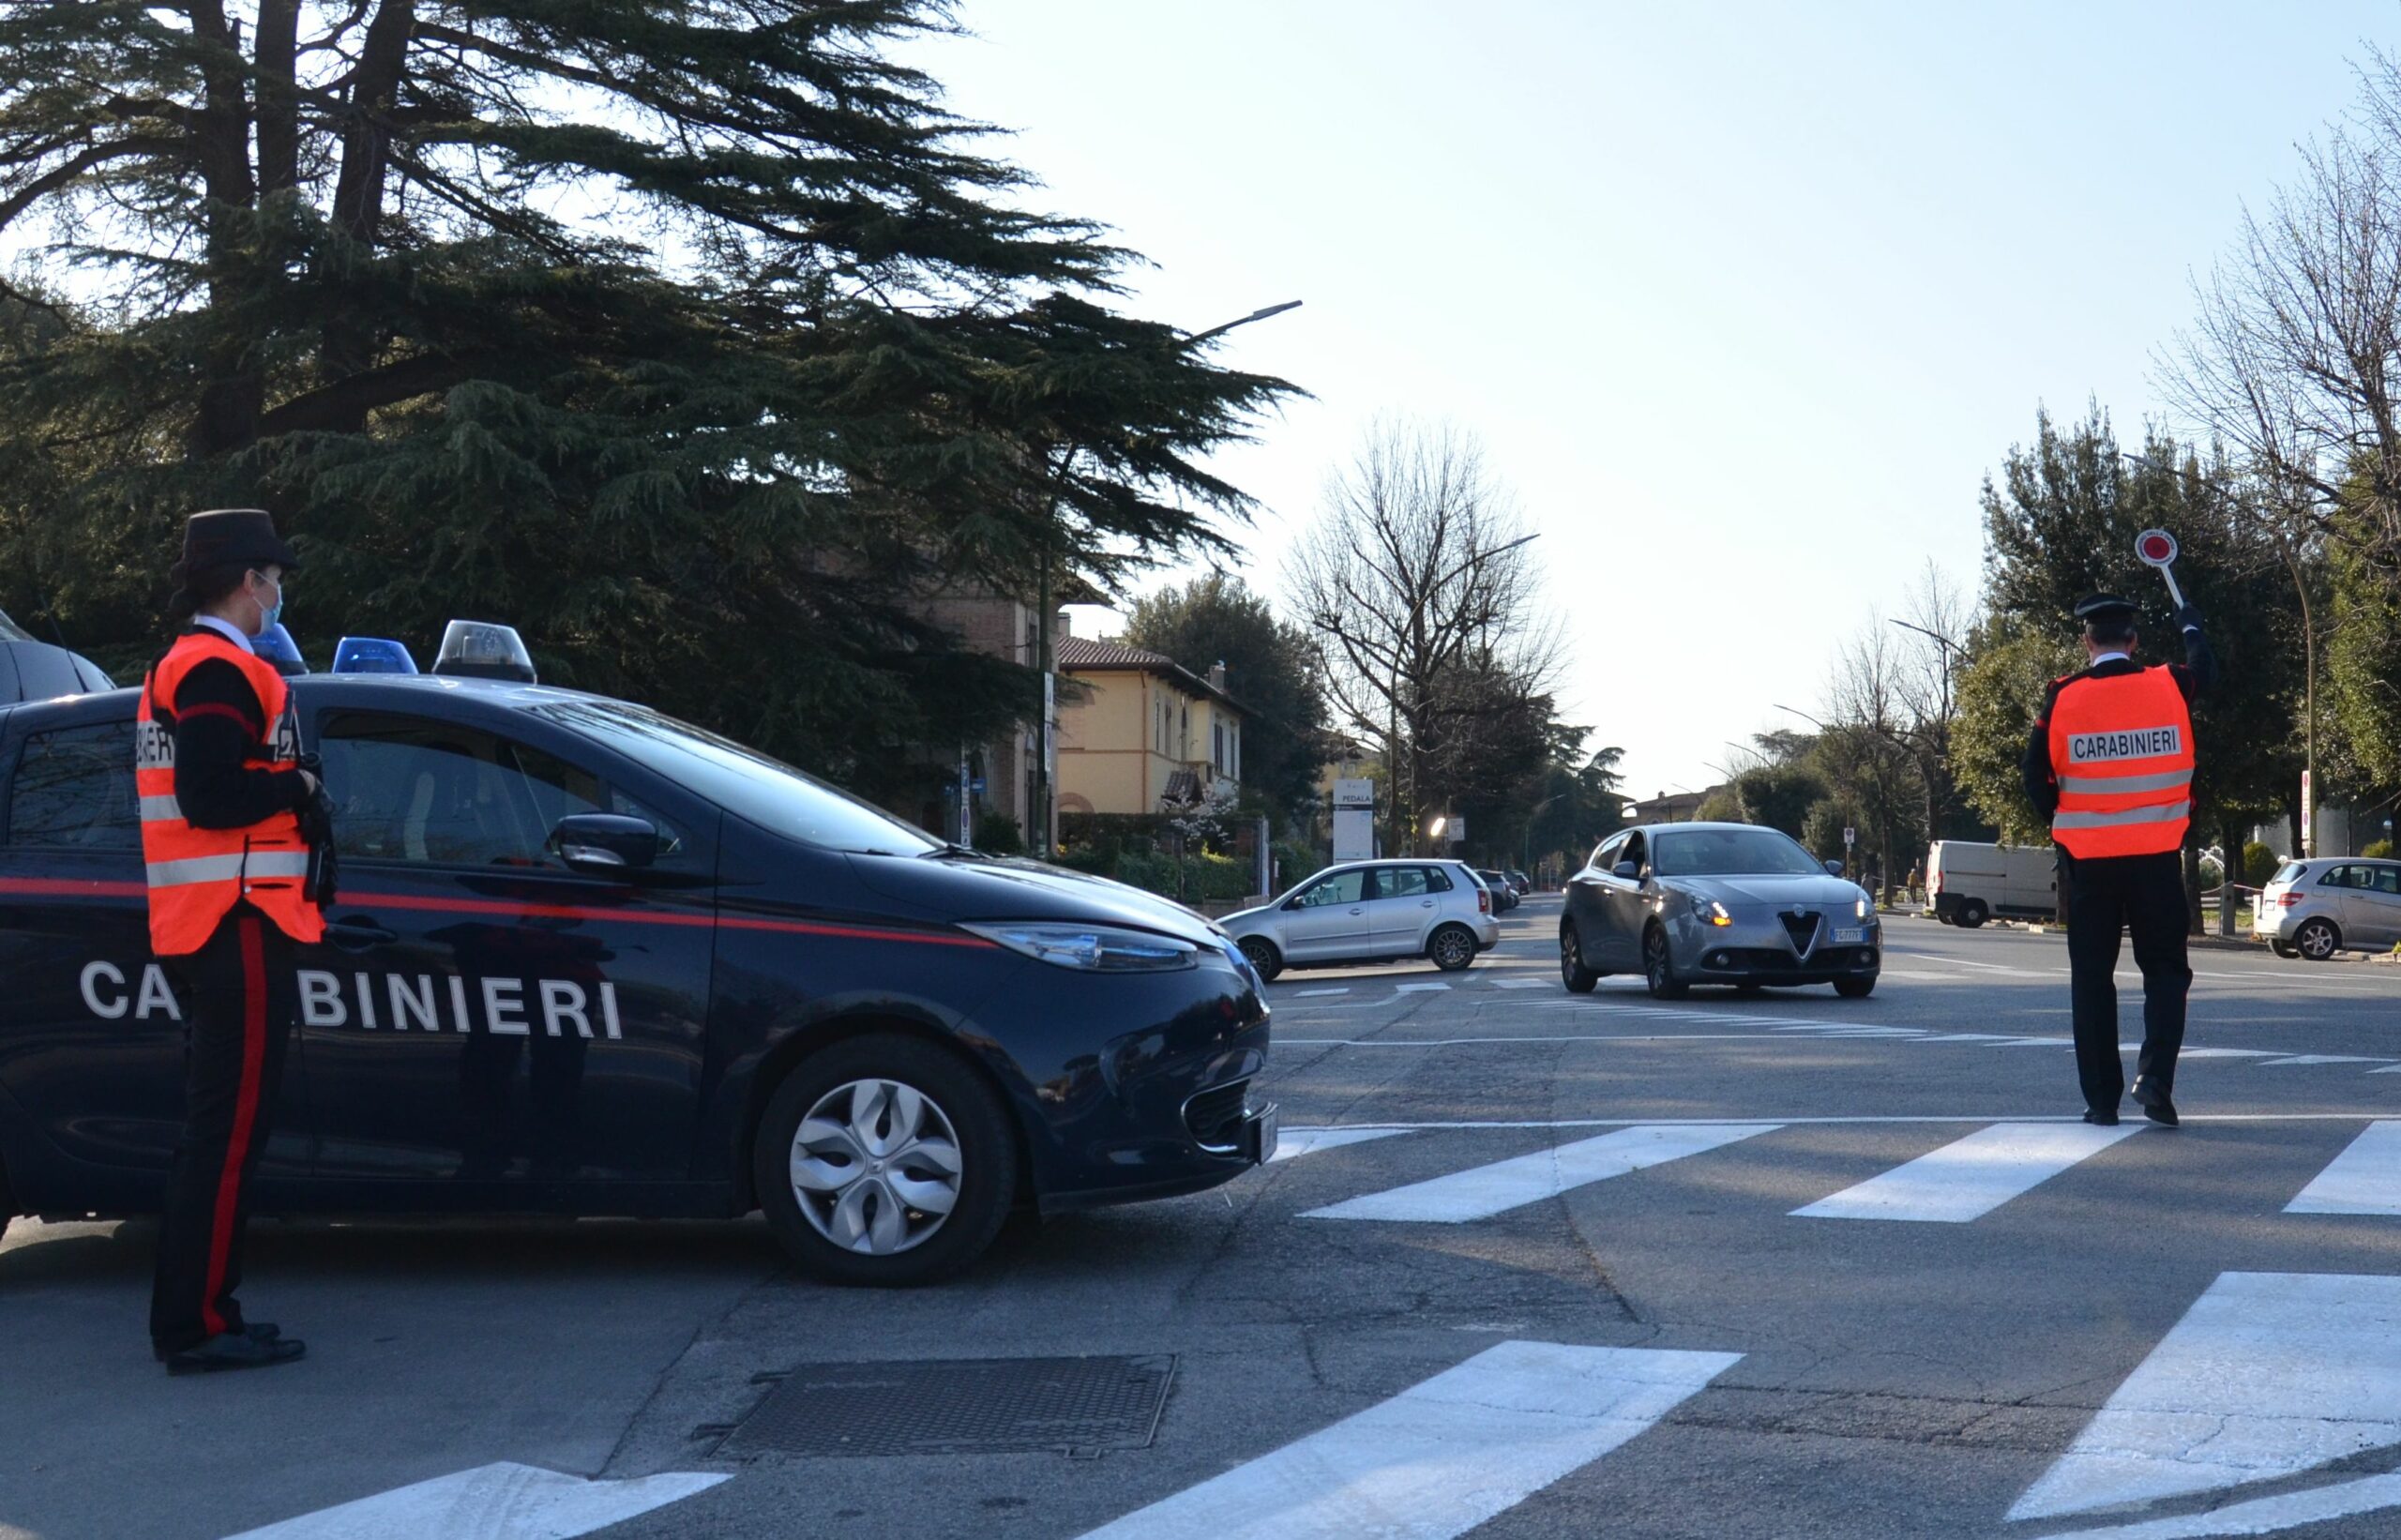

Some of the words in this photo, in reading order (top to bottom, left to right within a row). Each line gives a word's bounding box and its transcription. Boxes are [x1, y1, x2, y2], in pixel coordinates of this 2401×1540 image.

[2074, 730, 2177, 759] CARABINIERI
[1342, 794, 1370, 803] PEDALA
[80, 960, 622, 1039] CABINIERI
